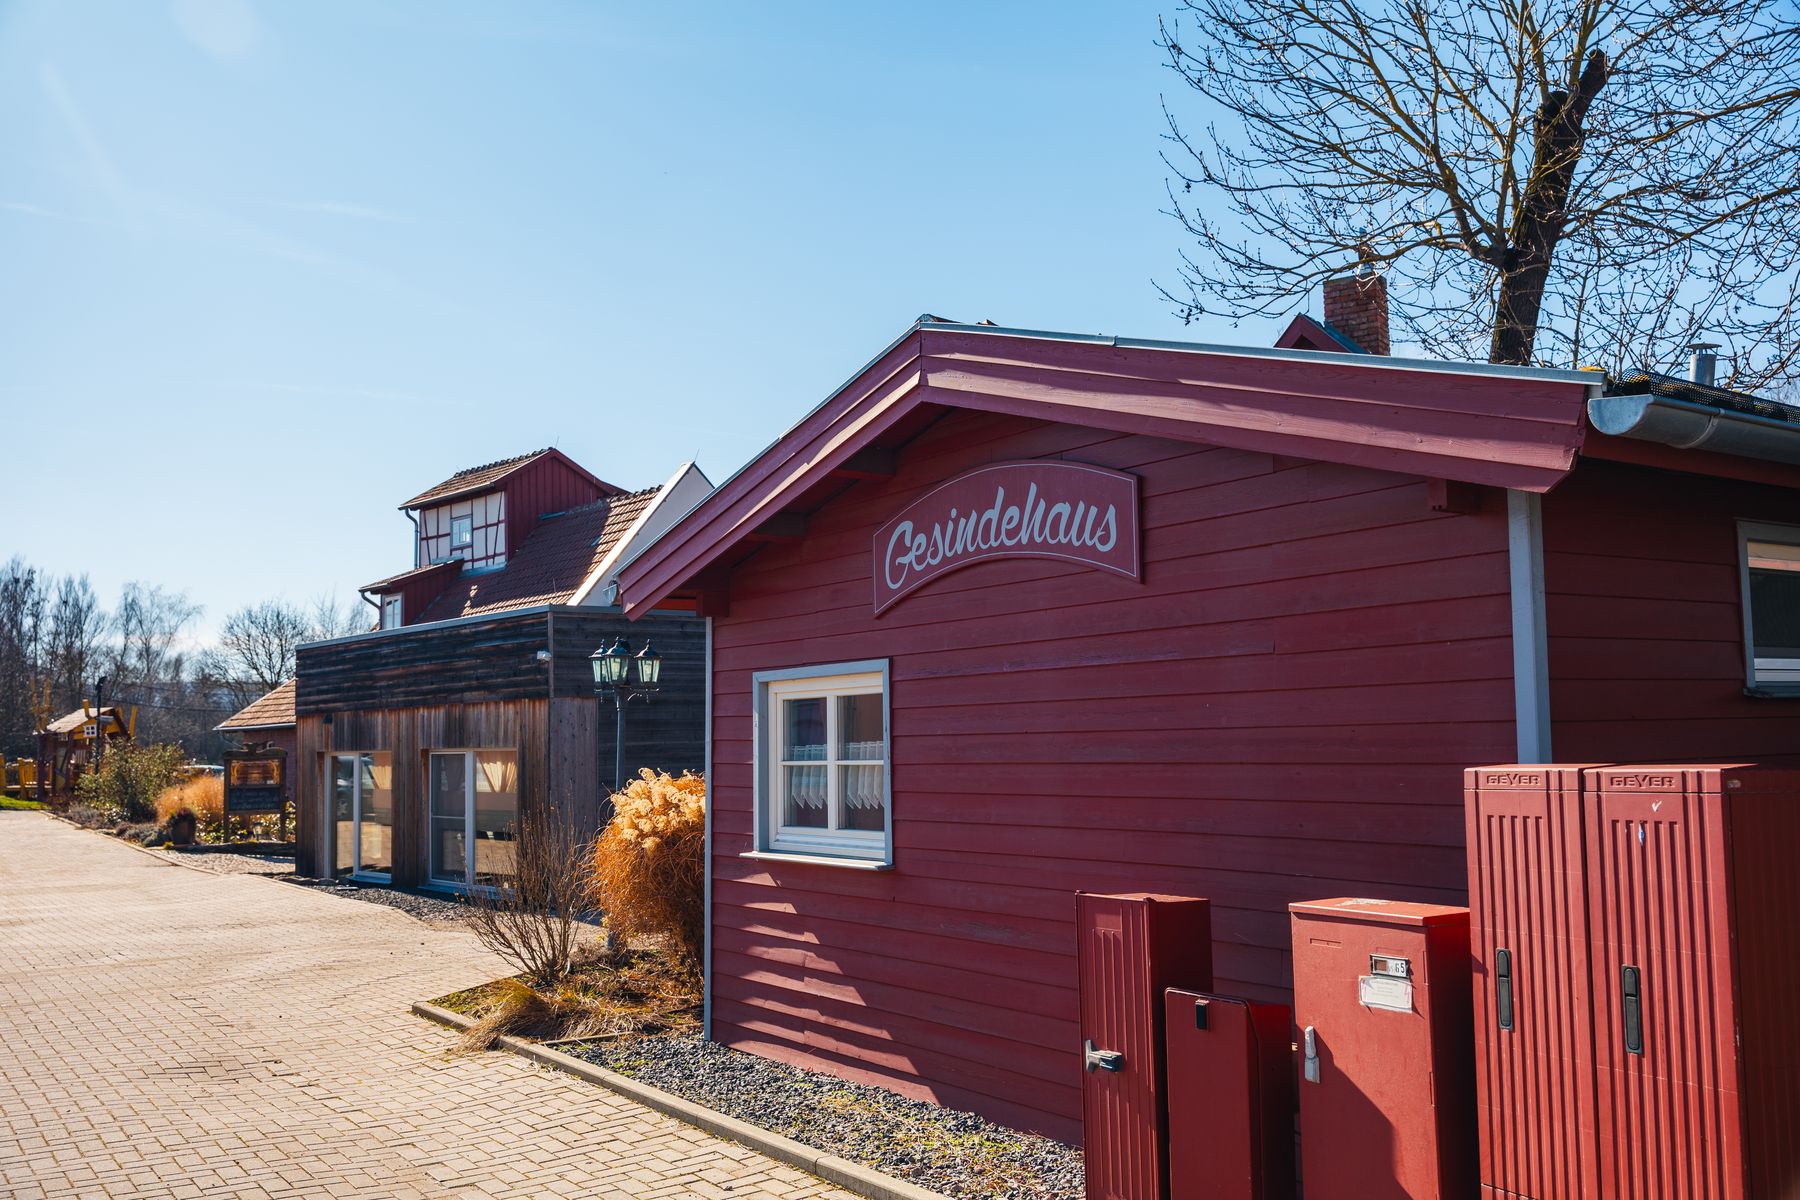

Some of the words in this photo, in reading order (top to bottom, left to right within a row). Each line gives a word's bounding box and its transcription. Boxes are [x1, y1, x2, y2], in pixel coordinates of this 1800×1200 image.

[885, 482, 1117, 589] Gesindehaus
[1486, 773, 1541, 787] GEYER
[1610, 775, 1676, 789] GEYER
